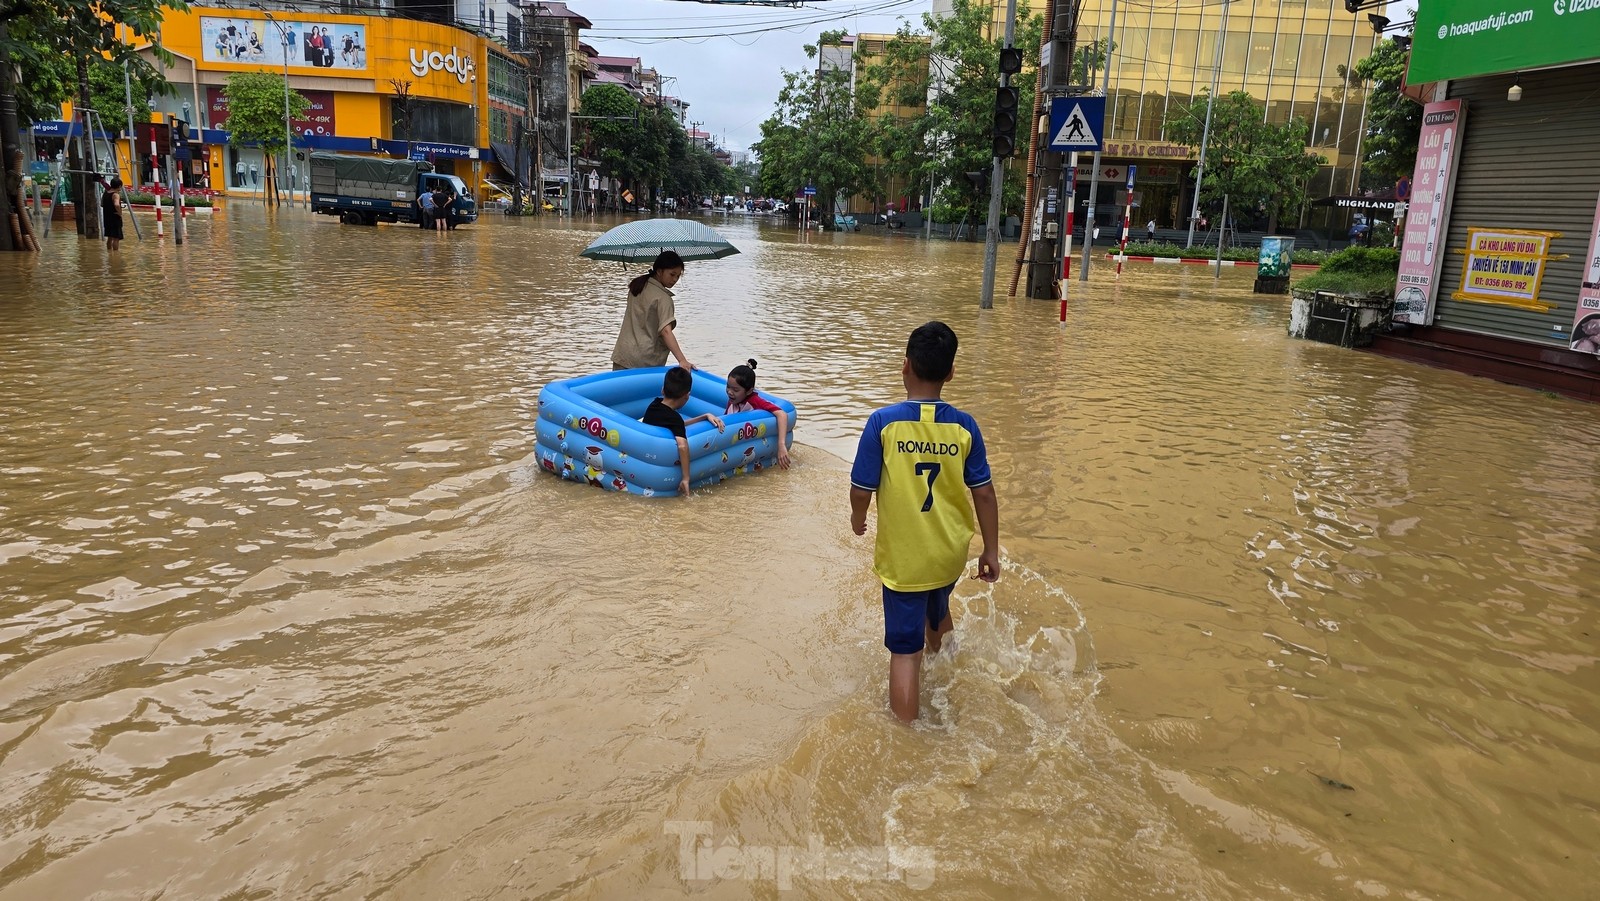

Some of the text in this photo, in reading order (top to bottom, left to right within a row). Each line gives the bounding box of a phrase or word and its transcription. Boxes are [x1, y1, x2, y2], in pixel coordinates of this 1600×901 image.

[1449, 9, 1534, 37] hoaquafuji.com
[410, 46, 468, 84] yody
[1406, 230, 1427, 245] TRUNG
[1405, 249, 1421, 263] HOA
[1485, 278, 1500, 287] 0356
[1501, 280, 1513, 288] 085
[896, 440, 960, 457] RONALDO
[914, 462, 942, 513] 7
